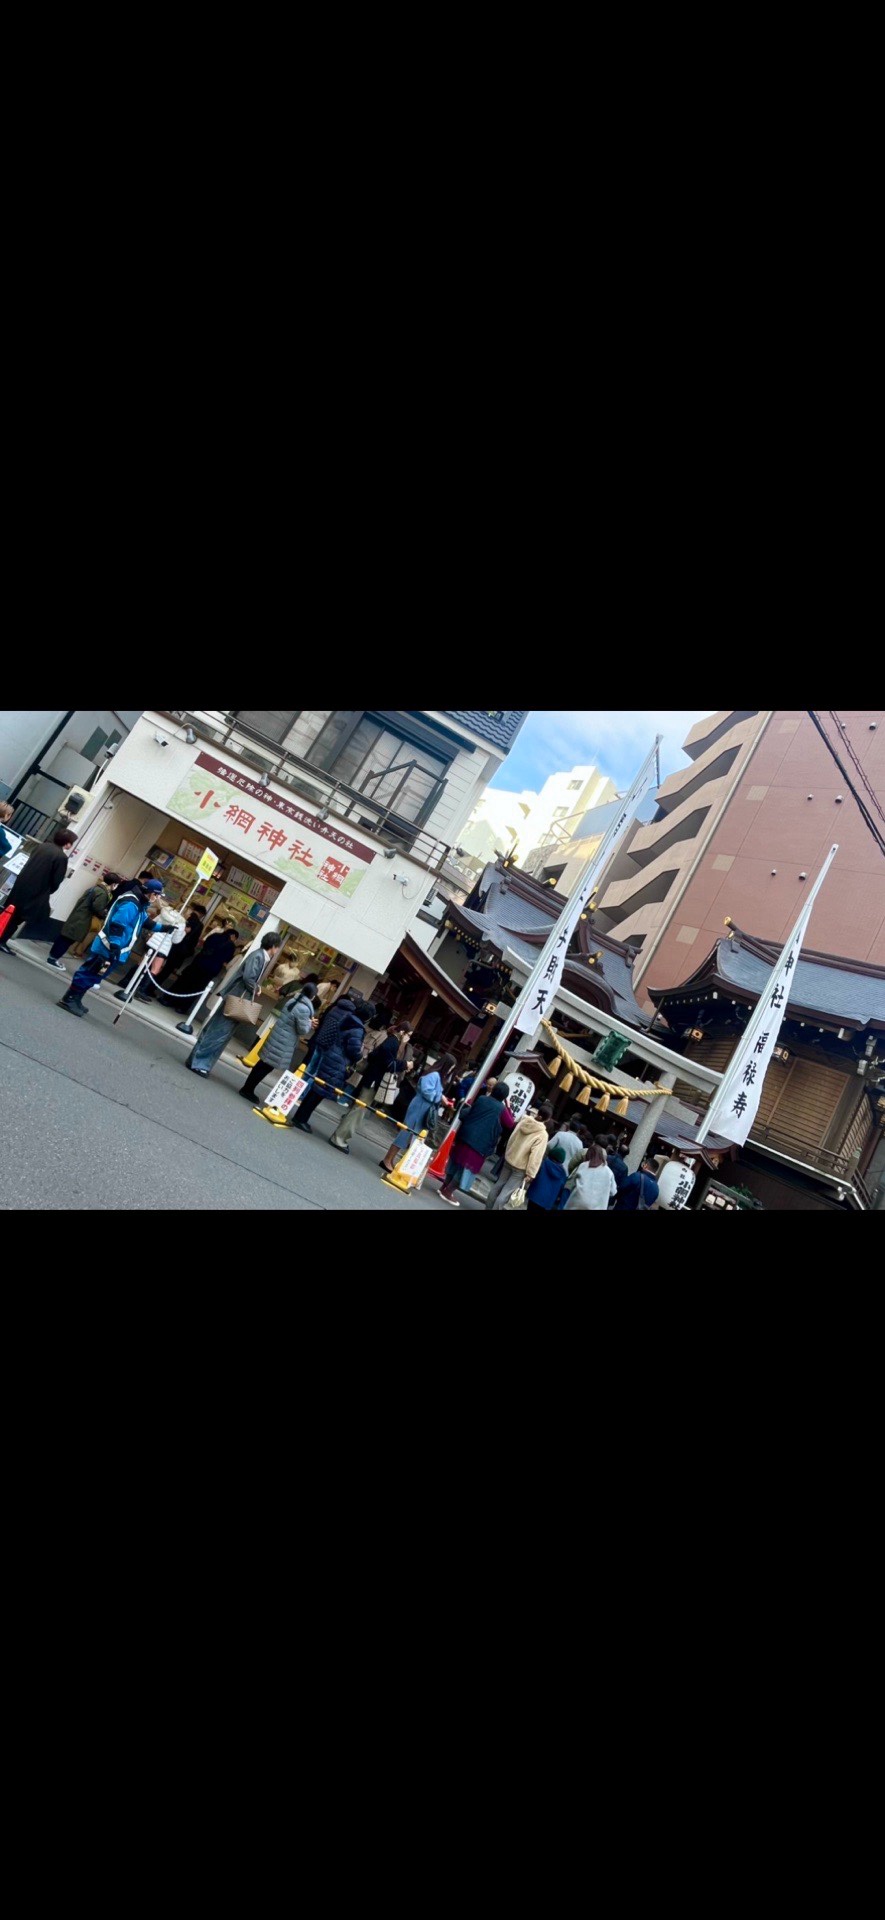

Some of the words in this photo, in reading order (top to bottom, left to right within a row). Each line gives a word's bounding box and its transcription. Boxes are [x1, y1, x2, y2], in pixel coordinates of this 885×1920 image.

[194, 790, 313, 867] 小網神社
[270, 1076, 290, 1103] お願いします
[731, 1031, 769, 1119] 福禄寿
